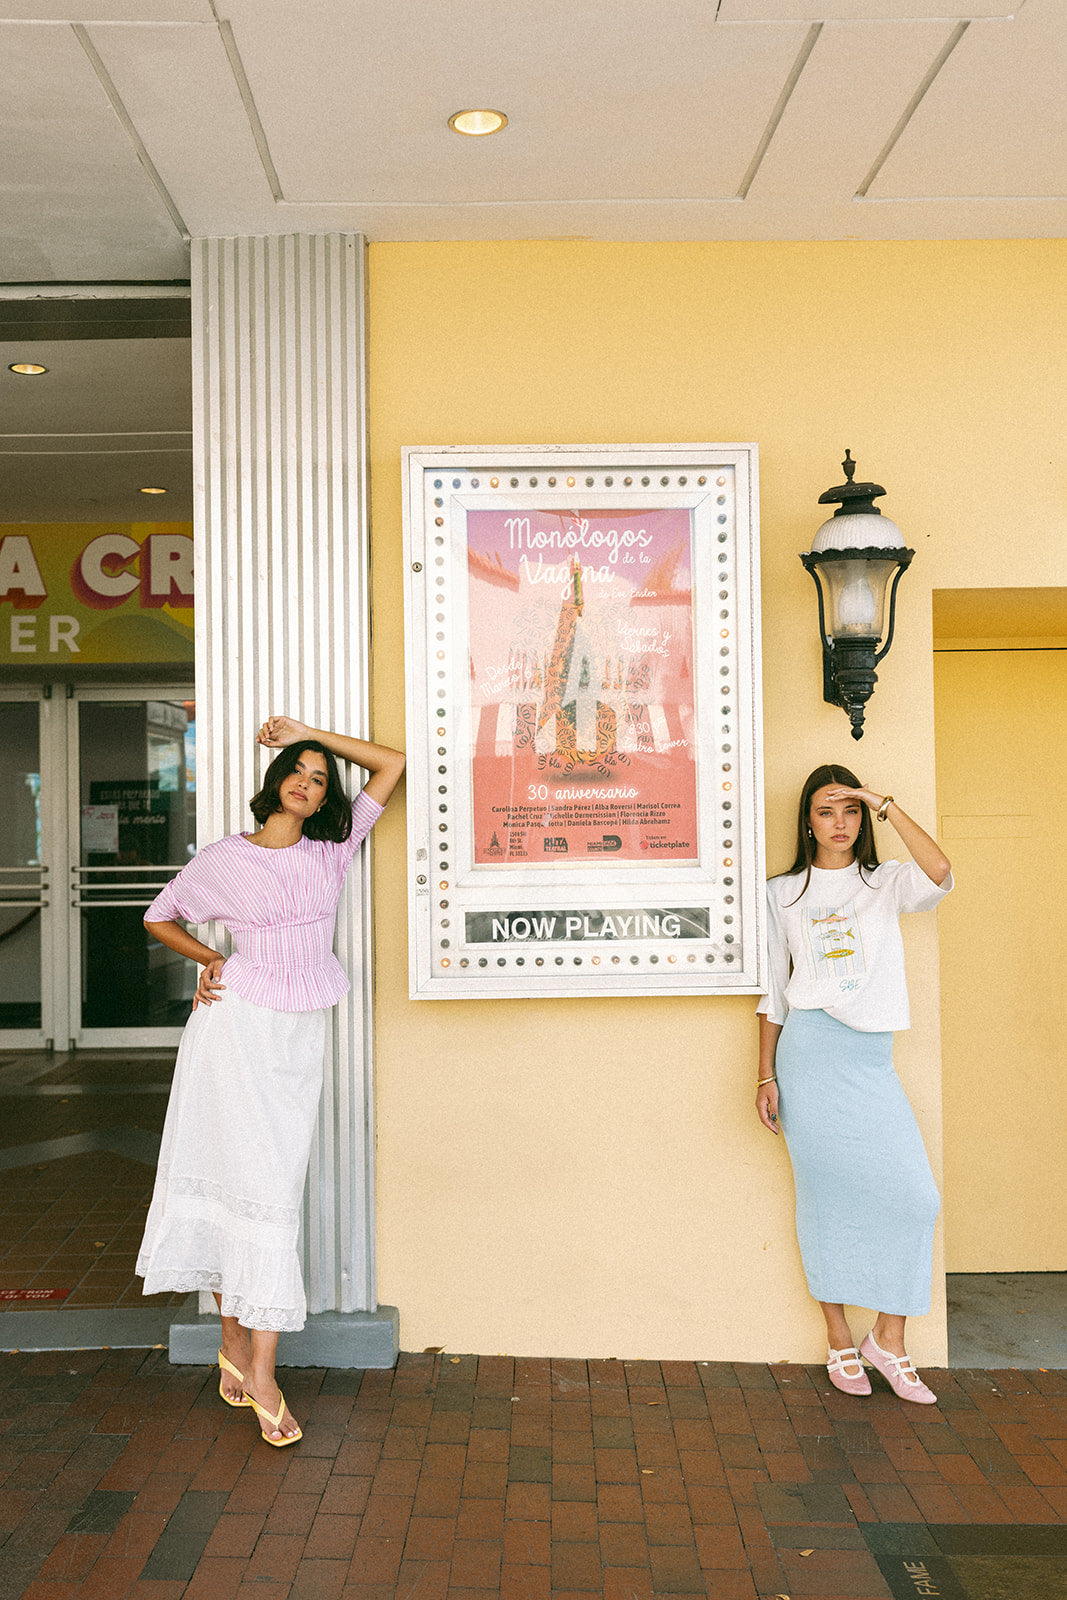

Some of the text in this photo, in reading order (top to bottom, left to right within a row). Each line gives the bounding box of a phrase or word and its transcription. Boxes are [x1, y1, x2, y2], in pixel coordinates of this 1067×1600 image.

[504, 518, 653, 563] Monólogos
[622, 552, 651, 563] de la
[10, 615, 80, 652] ER
[616, 619, 671, 646] Viernes y
[548, 757, 562, 768] bla
[527, 785, 638, 800] 30 aniversario
[567, 818, 591, 826] Daniela
[649, 840, 690, 850] ticketplate
[492, 914, 681, 940] NOW PLAYING
[903, 1561, 940, 1595] FAME
